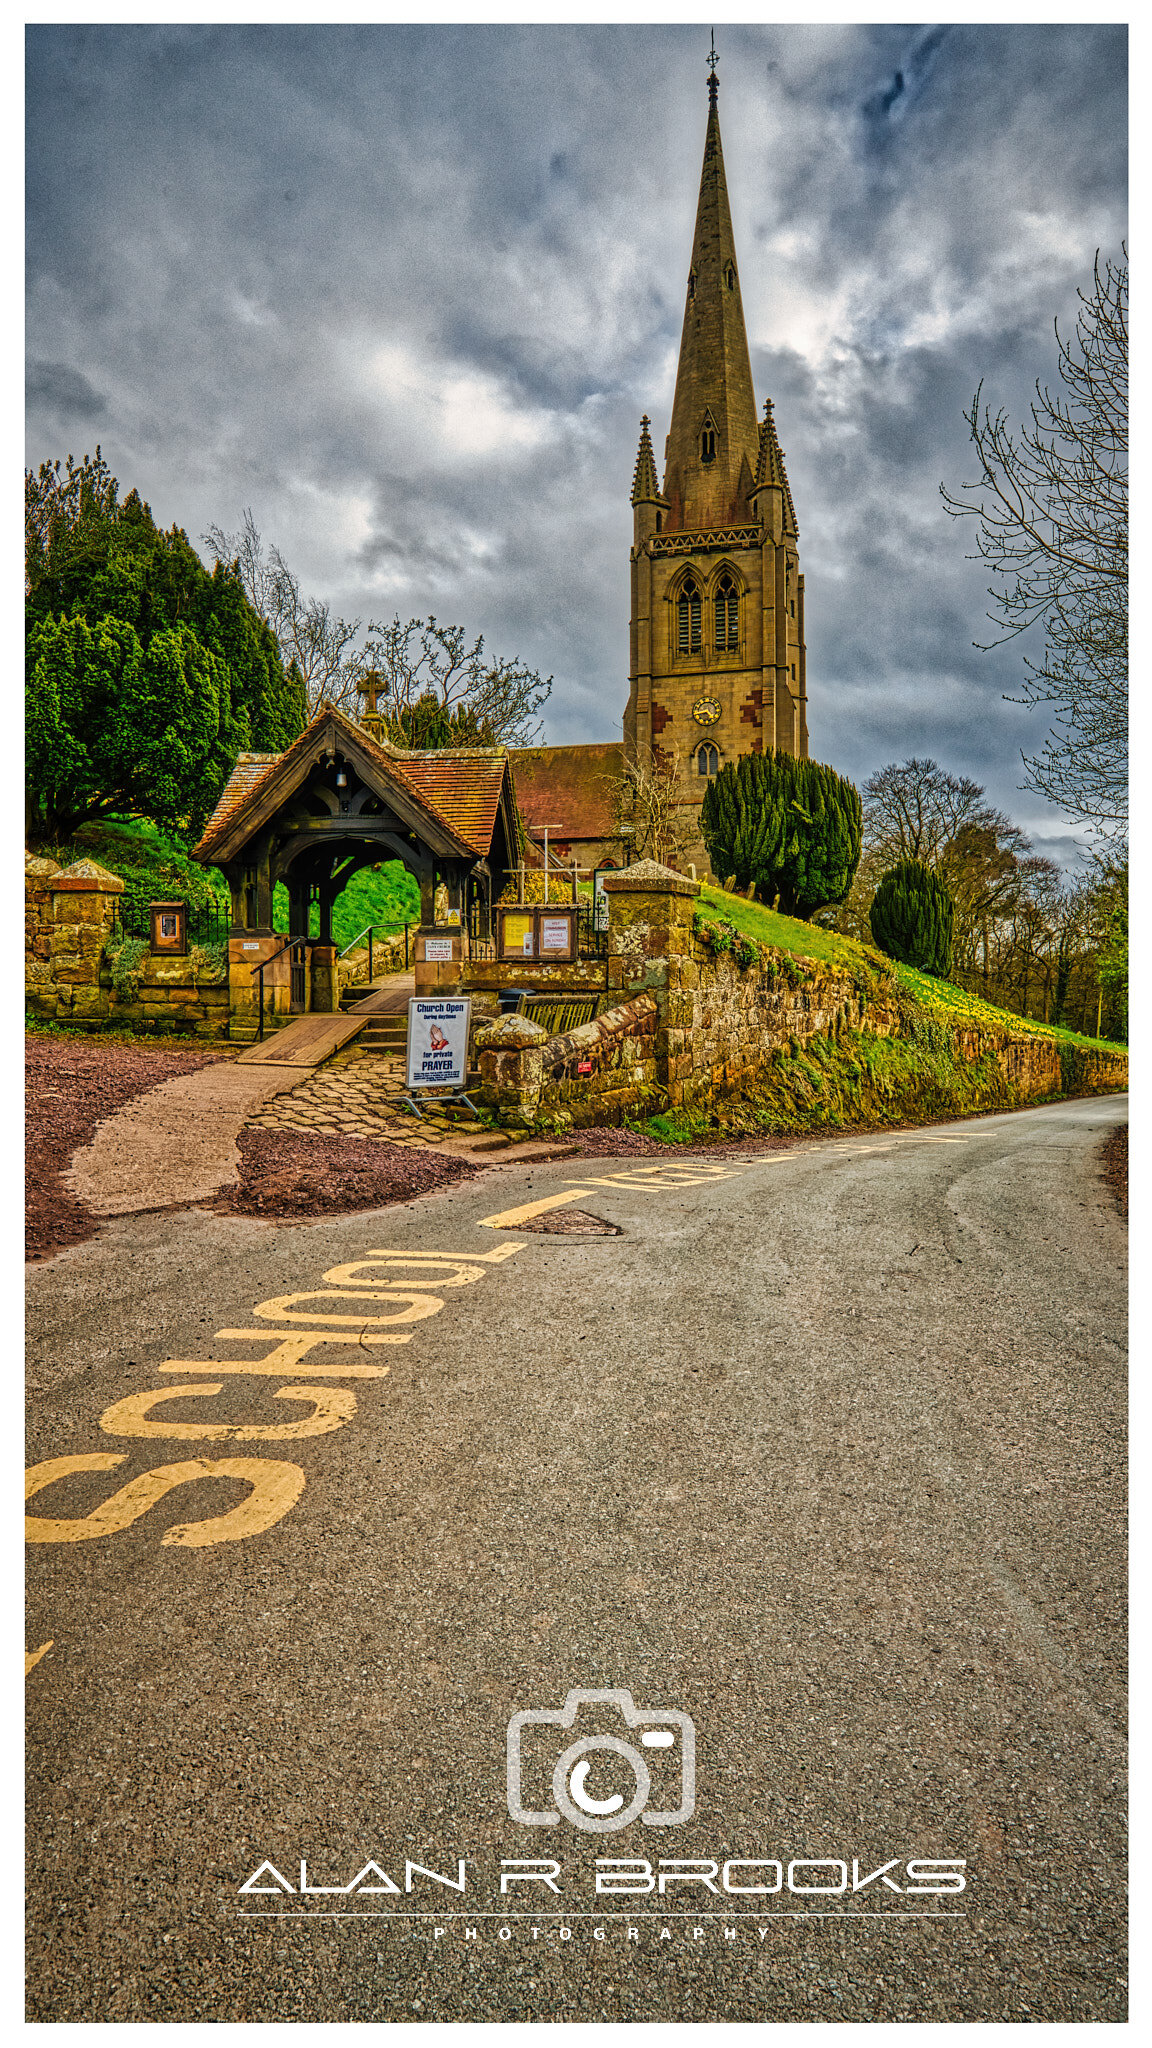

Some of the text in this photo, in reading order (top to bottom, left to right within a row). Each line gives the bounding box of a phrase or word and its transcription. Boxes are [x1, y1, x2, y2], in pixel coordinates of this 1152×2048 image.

[417, 1003, 464, 1013] Church Open
[433, 1051, 453, 1059] private
[422, 1060, 453, 1071] PRAYER
[562, 1163, 743, 1192] KEEP
[25, 1242, 529, 1547] SCHOOL
